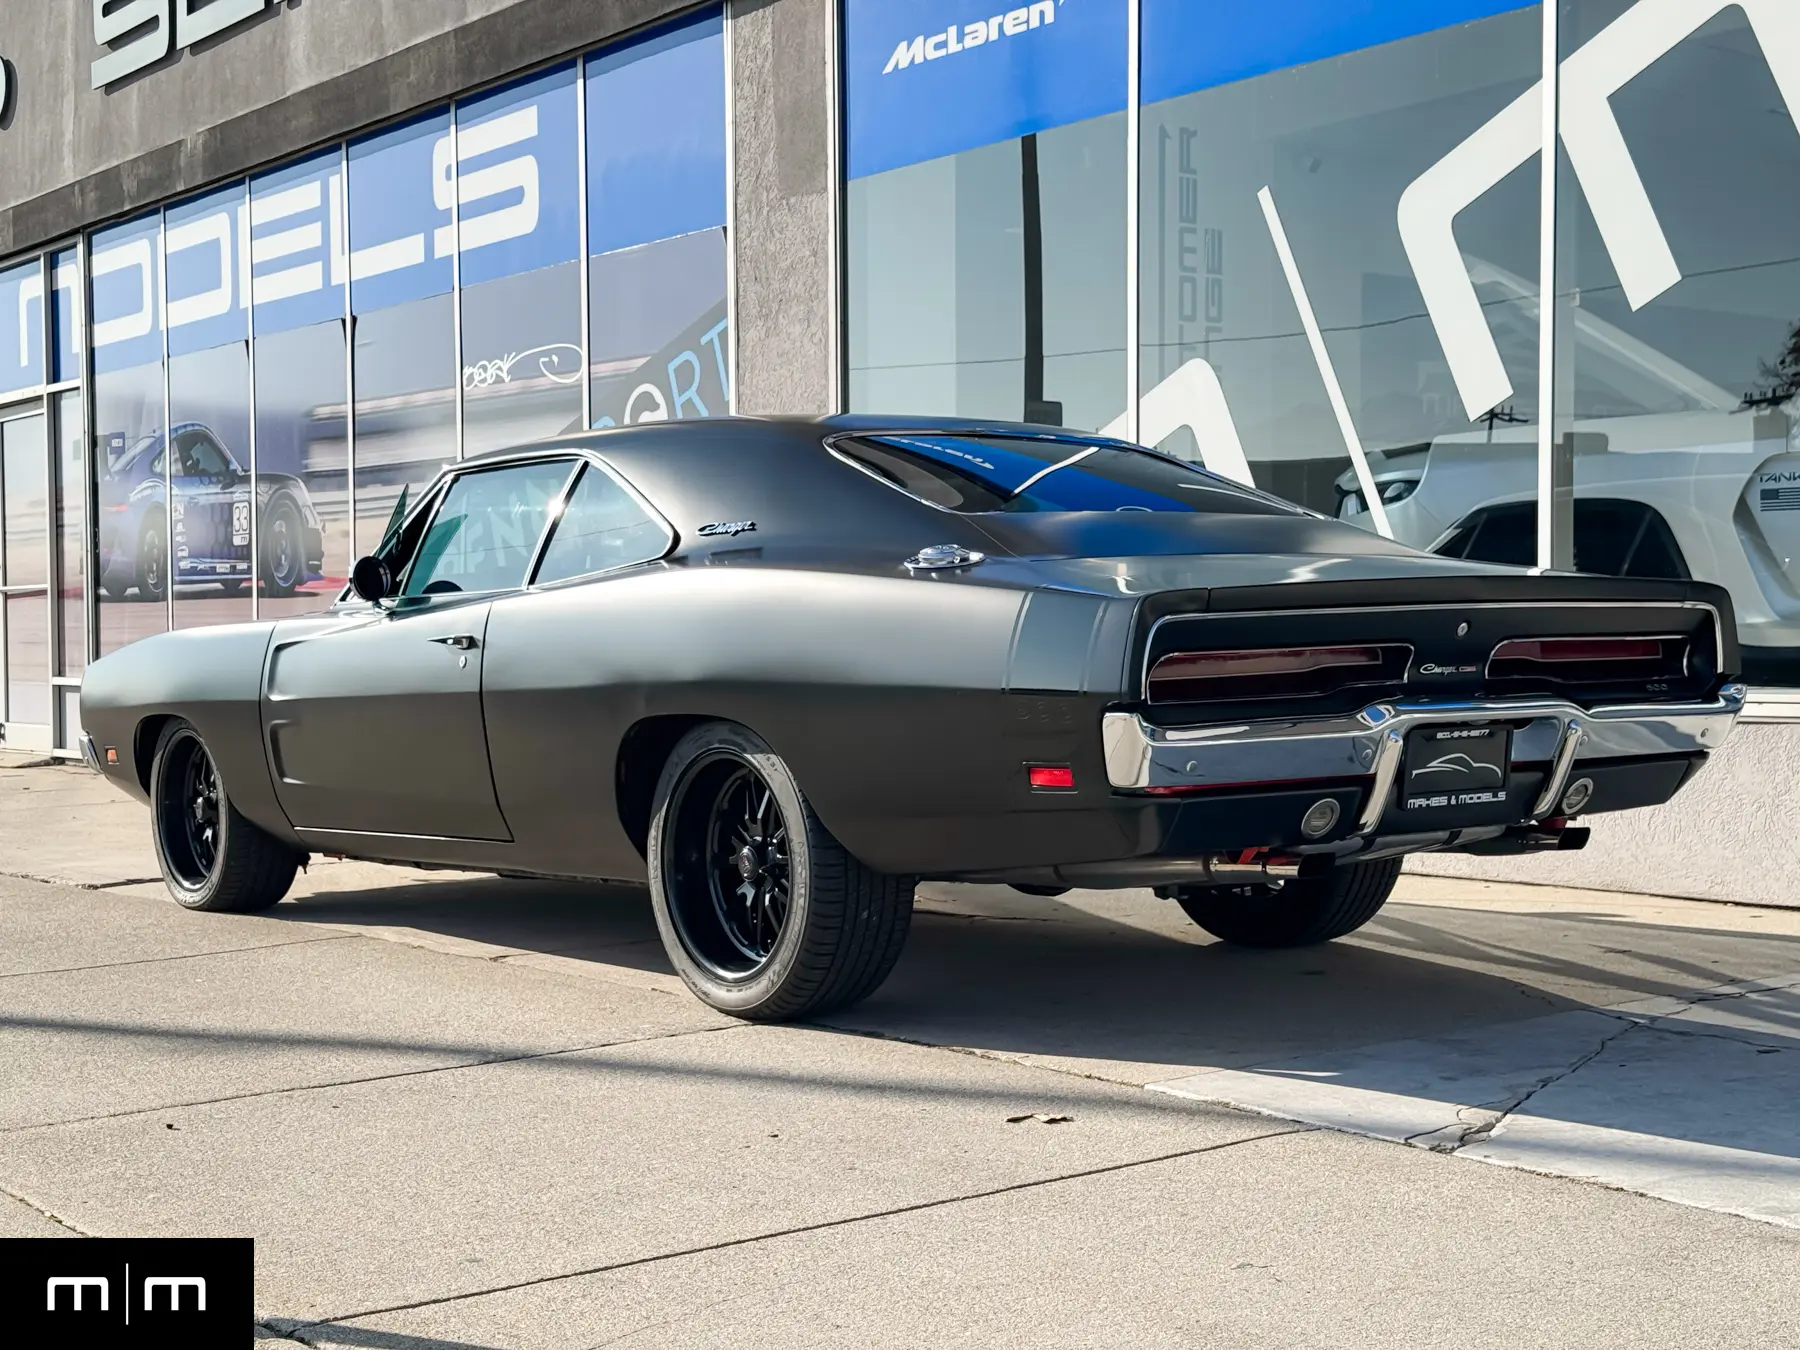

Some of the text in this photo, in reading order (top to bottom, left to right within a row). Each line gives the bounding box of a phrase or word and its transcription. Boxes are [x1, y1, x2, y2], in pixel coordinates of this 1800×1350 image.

[882, 0, 1055, 75] McLaren
[19, 105, 540, 368] MODELS
[1178, 126, 1198, 366] TOMER
[234, 506, 249, 533] 33
[695, 521, 757, 537] Charger
[1420, 663, 1457, 676] Charger
[1407, 791, 1506, 809] MAKES & MODELS
